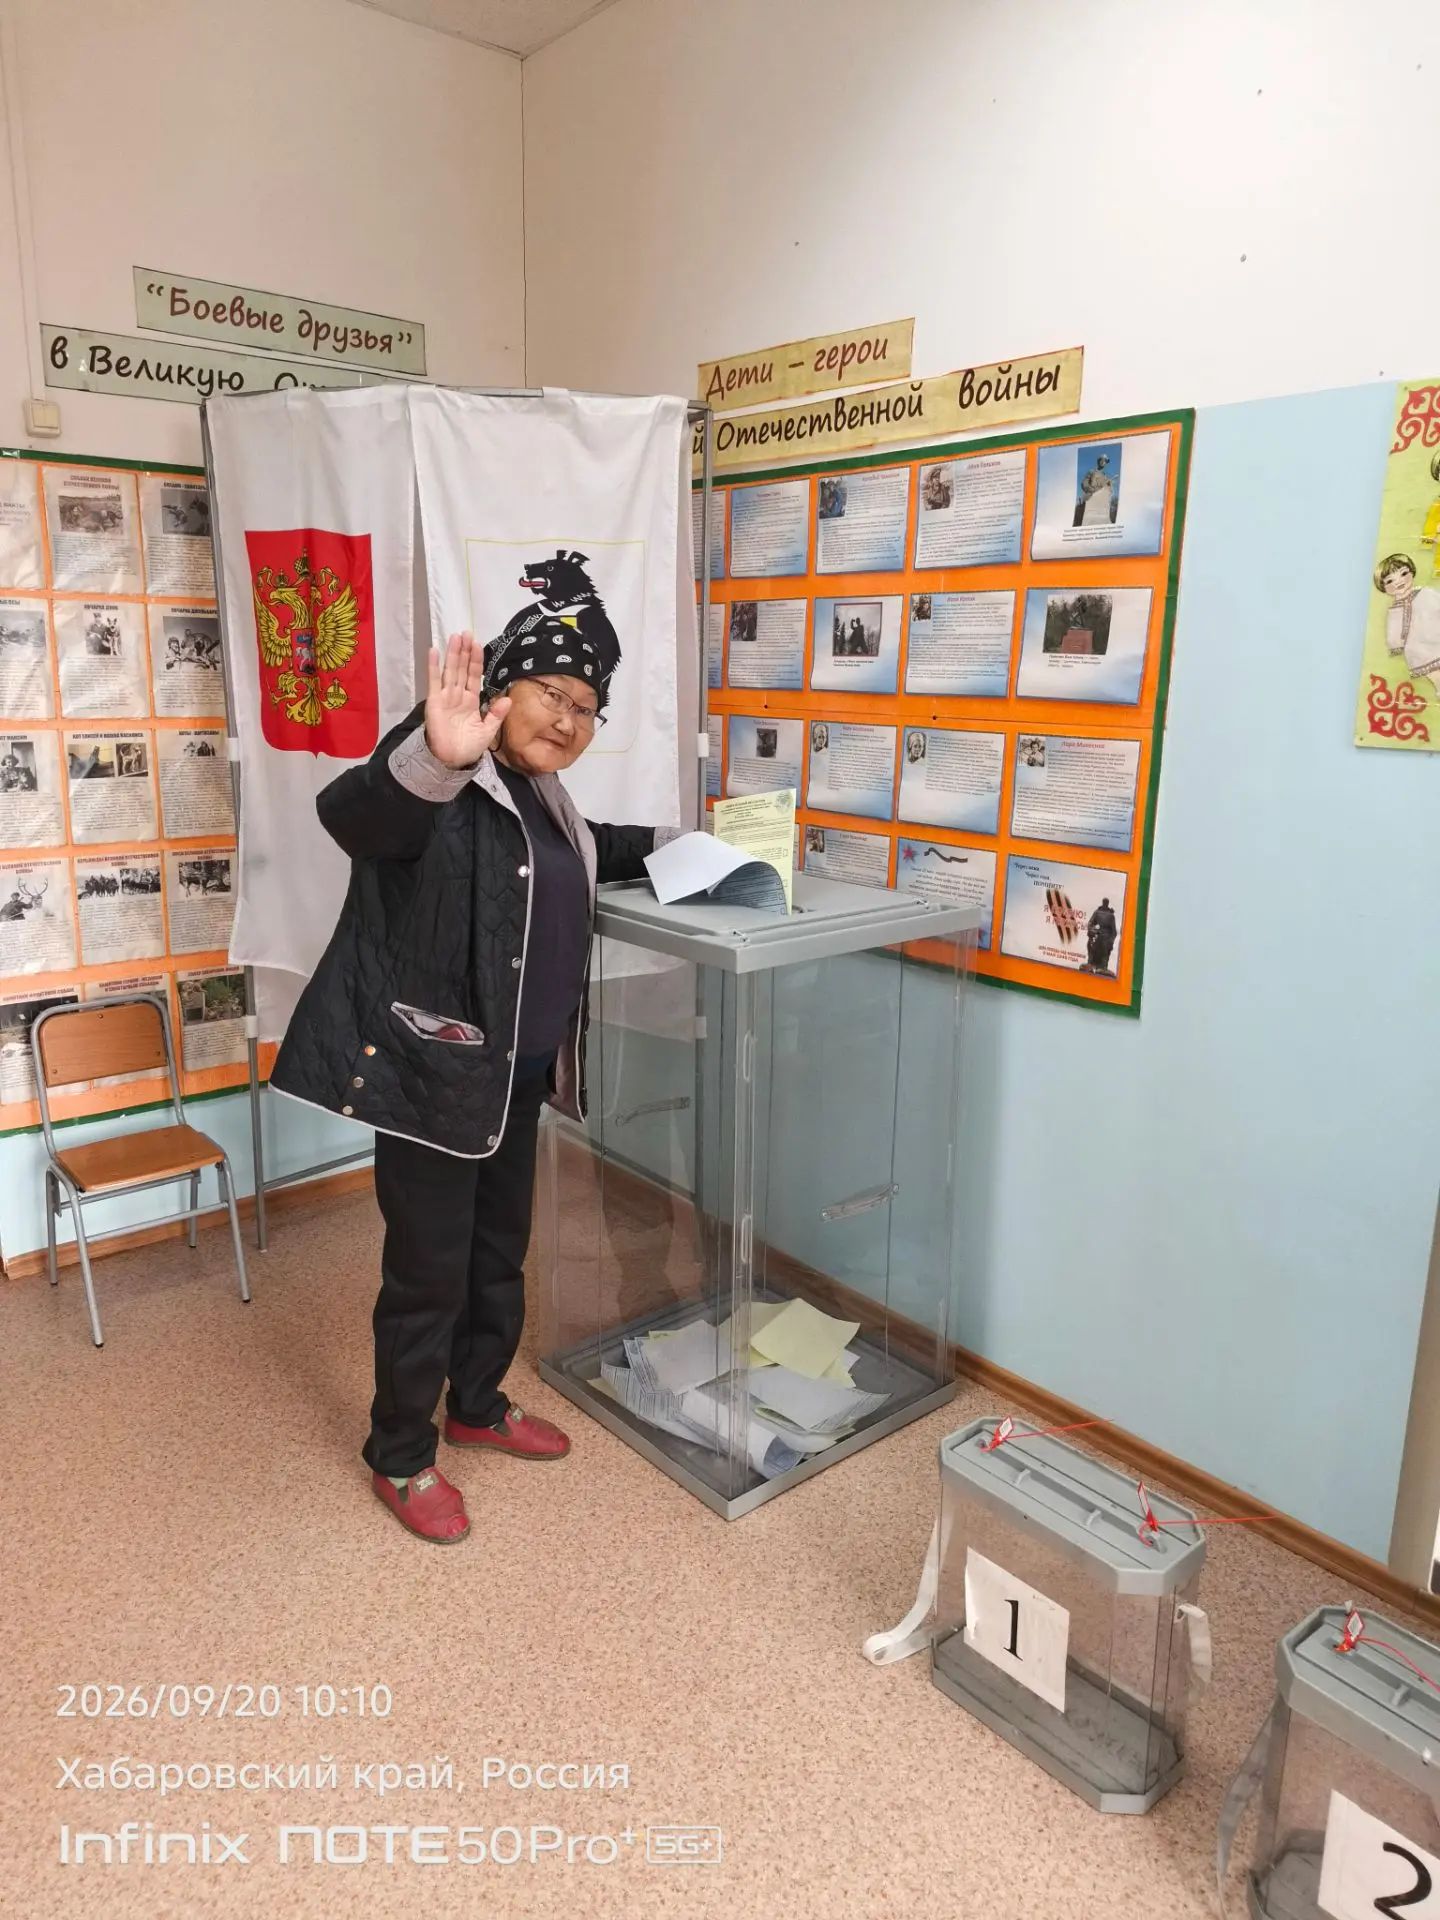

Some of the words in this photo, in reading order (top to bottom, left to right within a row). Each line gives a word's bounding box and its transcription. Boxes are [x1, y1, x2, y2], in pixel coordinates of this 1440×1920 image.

[50, 335, 69, 370] в
[88, 345, 244, 397] Великую
[705, 360, 773, 403] Дети
[813, 338, 889, 382] герои
[716, 383, 924, 453] Отечественной
[956, 363, 1061, 410] войны
[1003, 1599, 1024, 1661] 1
[1373, 1841, 1433, 1920] 2
